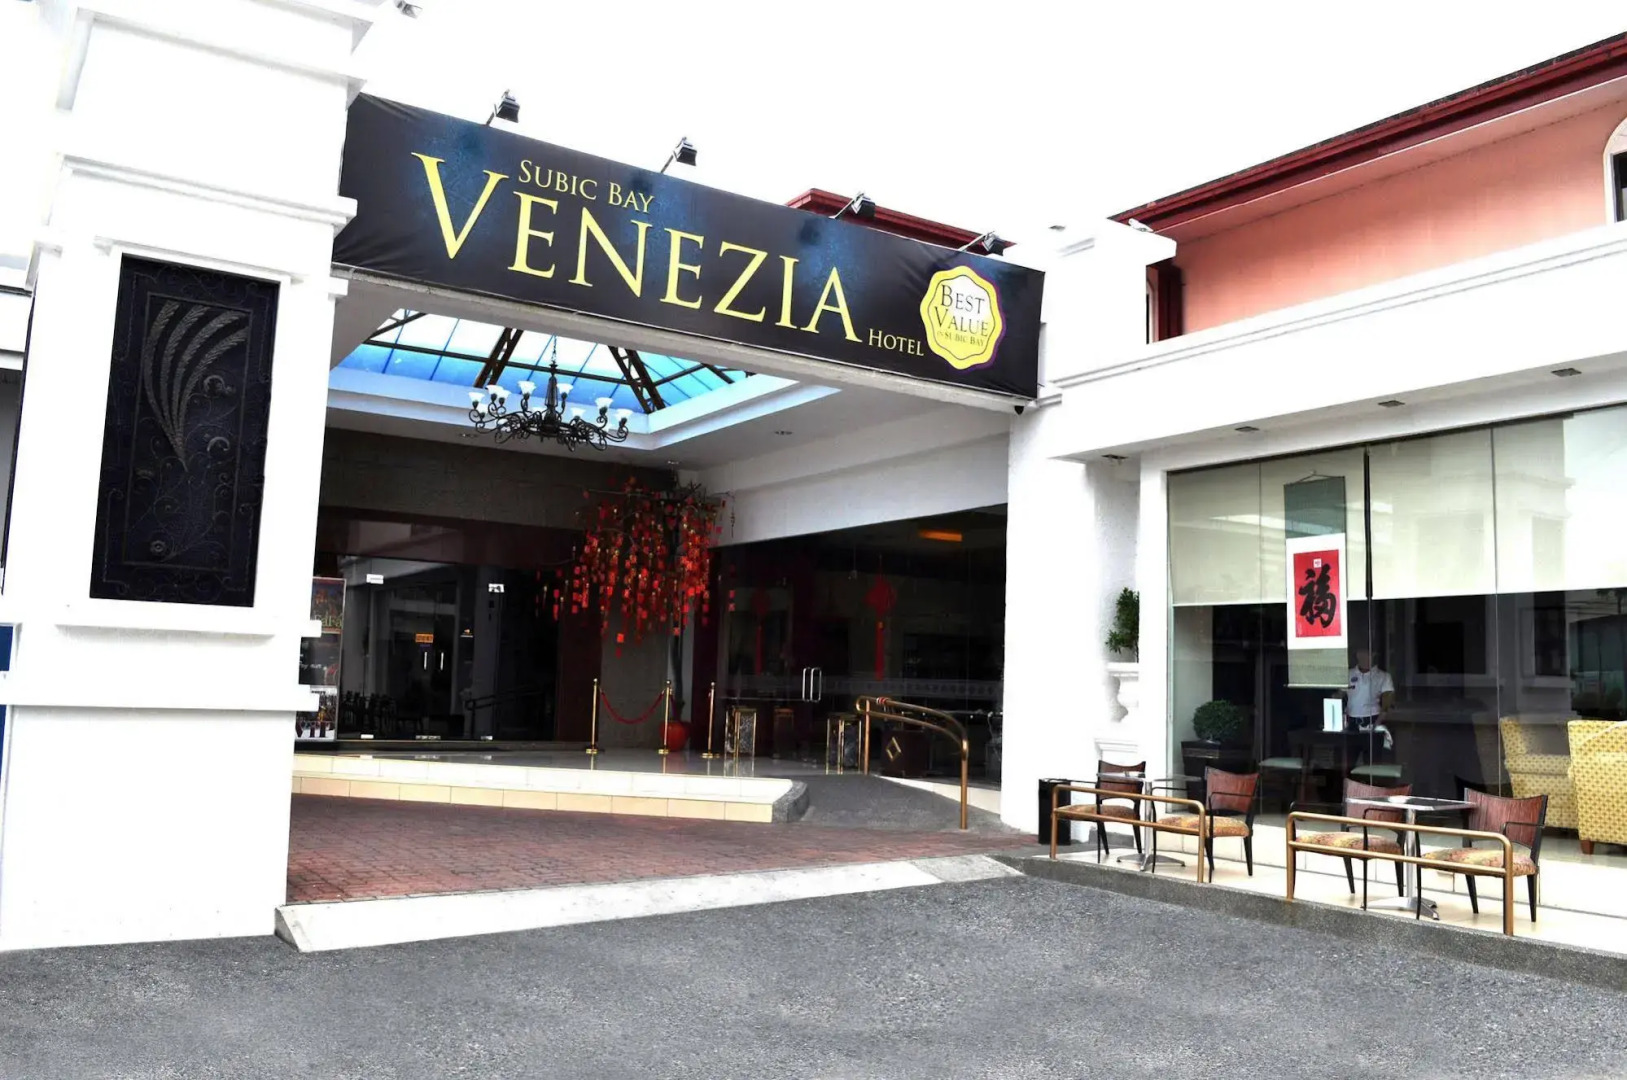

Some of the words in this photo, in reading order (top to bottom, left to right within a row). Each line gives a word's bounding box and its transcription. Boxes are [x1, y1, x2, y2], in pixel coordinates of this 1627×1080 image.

[518, 160, 597, 200] SUBIC
[608, 182, 654, 214] BAY
[411, 152, 863, 343] VENEZIA
[868, 328, 924, 357] HOTEL
[940, 284, 985, 314] BEST
[934, 305, 989, 337] VALUE
[970, 336, 984, 347] BAY
[1298, 563, 1336, 628] 福
